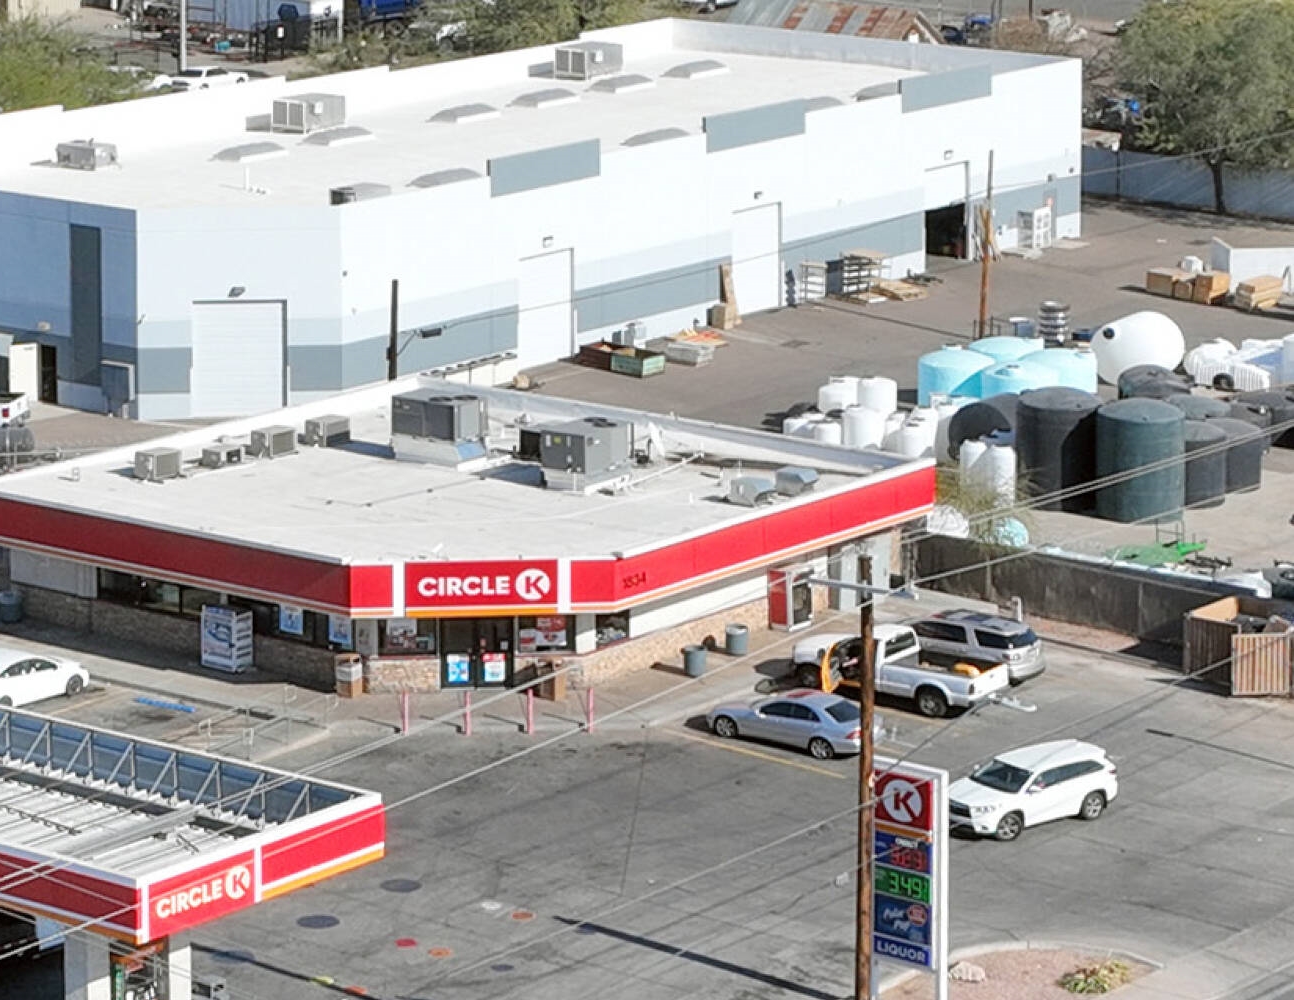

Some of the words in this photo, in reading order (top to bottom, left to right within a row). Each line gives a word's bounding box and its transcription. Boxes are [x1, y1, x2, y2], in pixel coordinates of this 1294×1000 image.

[417, 575, 510, 597] CIRCLE
[156, 878, 222, 918] CIRCLE
[876, 939, 926, 963] LIQUOR
